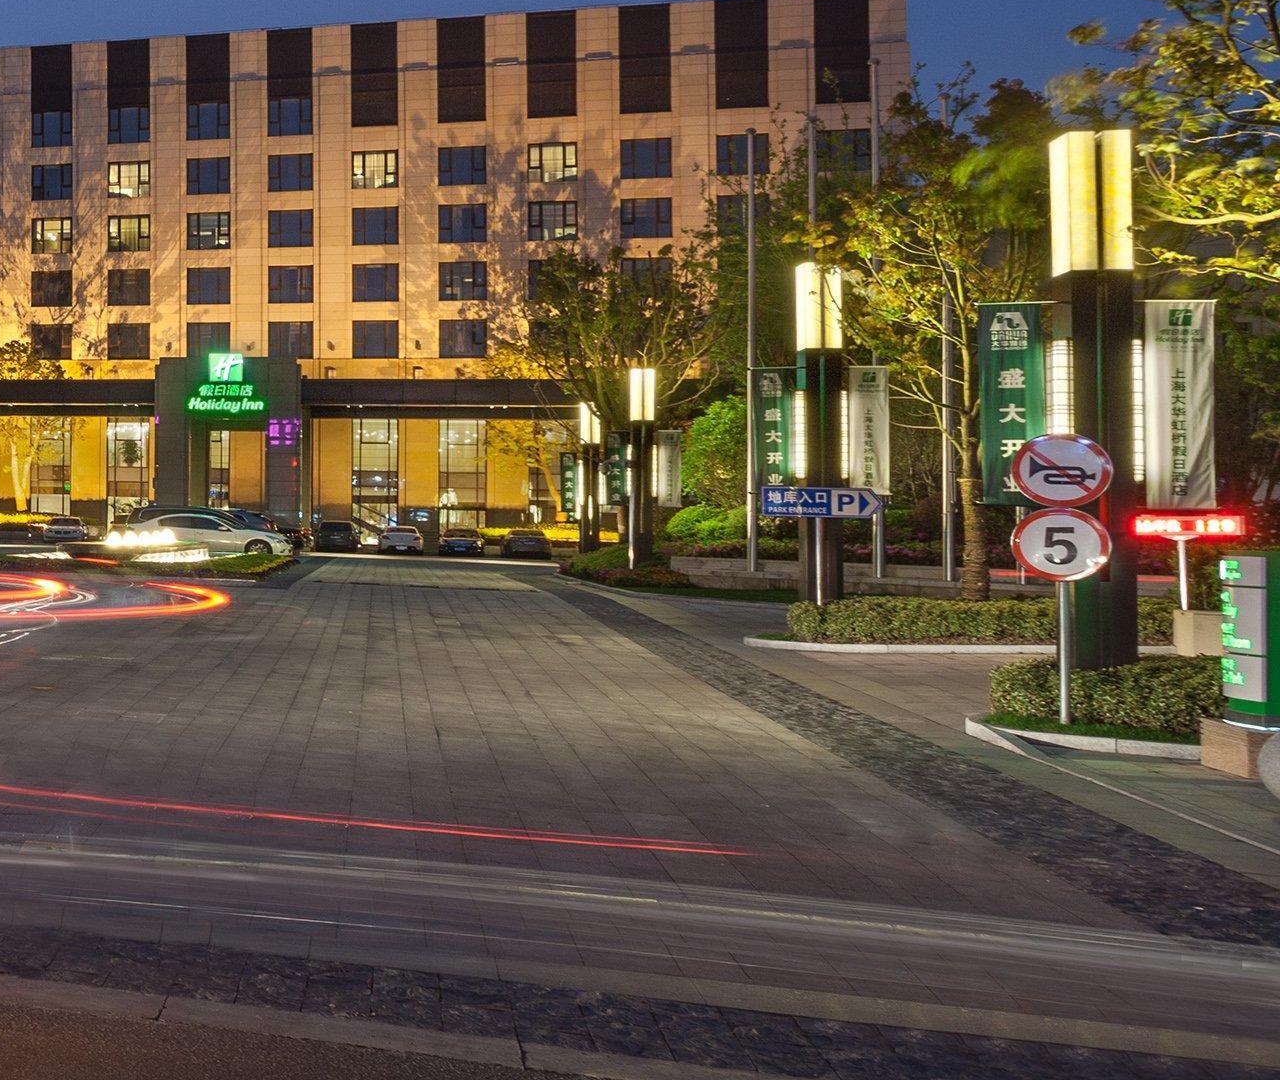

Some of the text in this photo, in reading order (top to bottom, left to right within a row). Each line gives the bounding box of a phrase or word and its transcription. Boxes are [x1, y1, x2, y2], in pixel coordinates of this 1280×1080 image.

[198, 384, 253, 397] 假日酒店
[188, 397, 264, 413] Holiday Inn
[1171, 368, 1189, 496] 上海大华虹桥假日酒店
[763, 407, 784, 486] 盛大开业
[767, 490, 827, 504] 地库入口
[837, 493, 855, 512] P
[1043, 527, 1078, 565] 5
